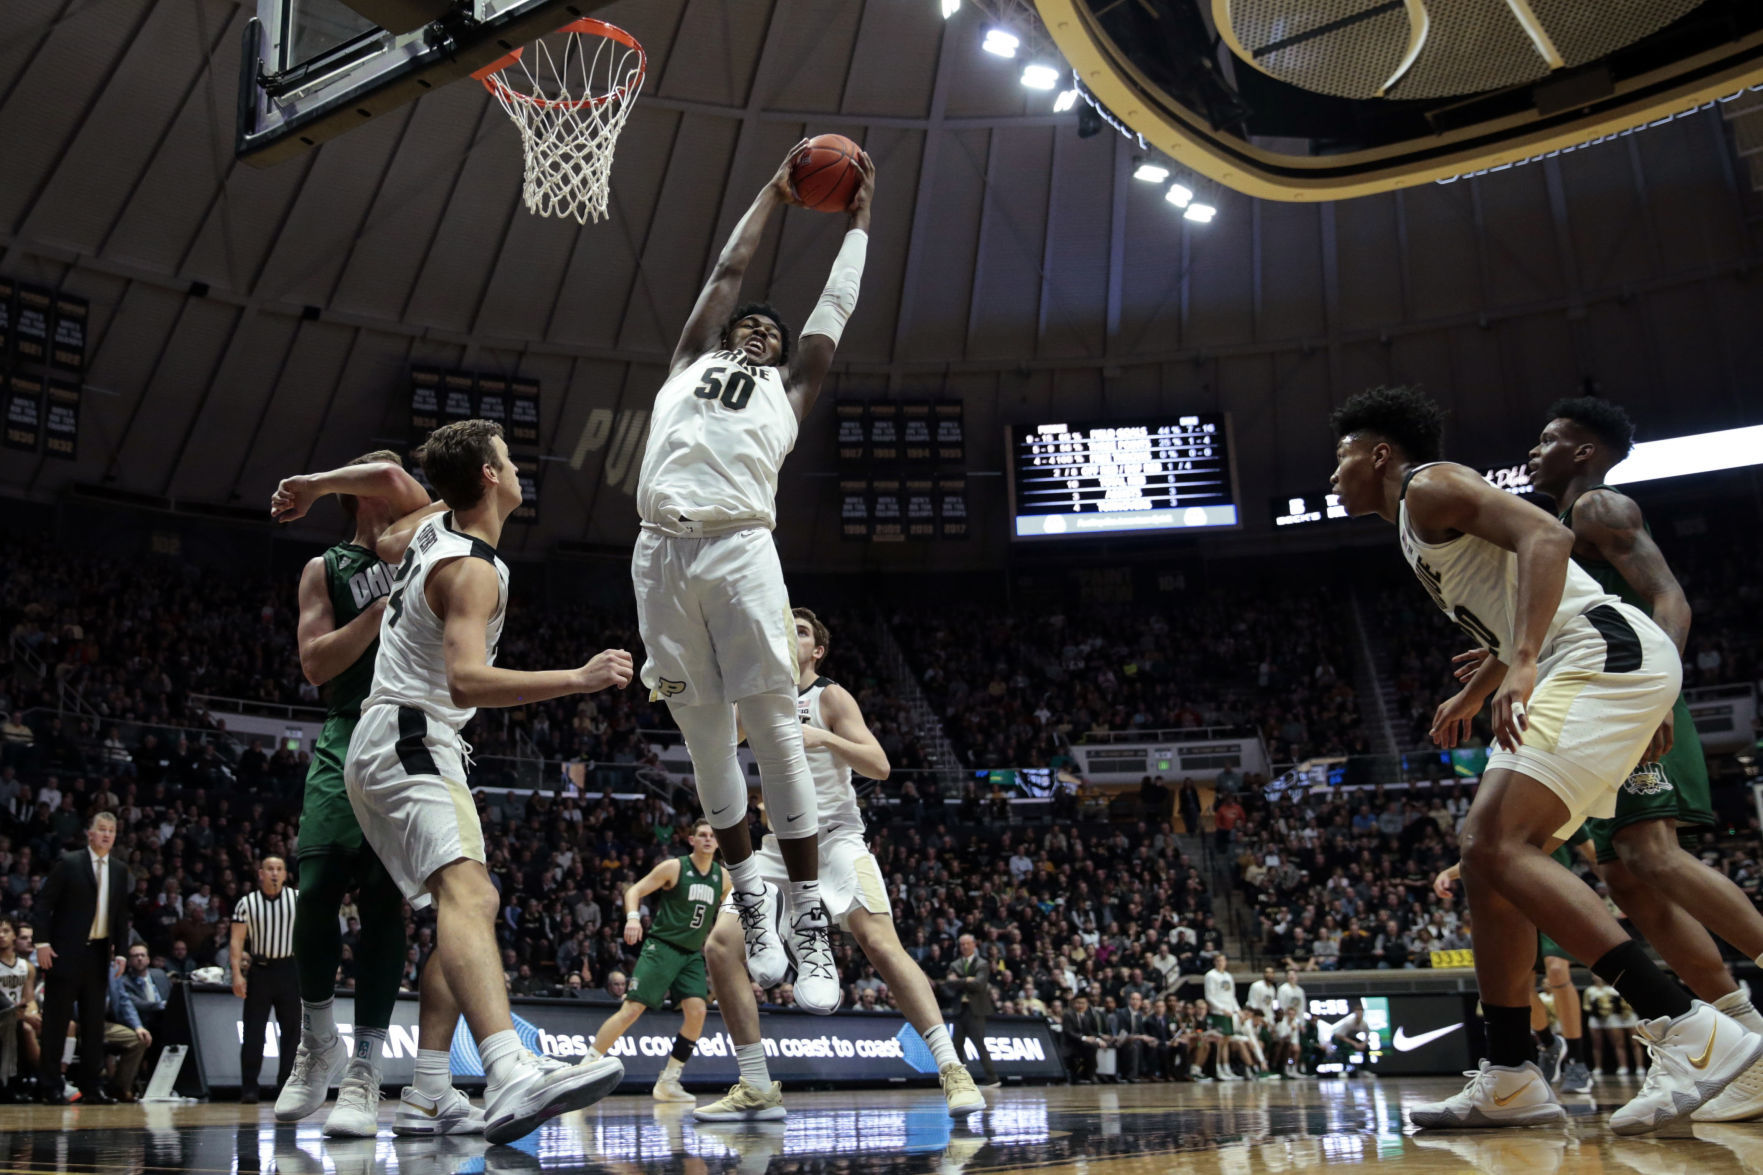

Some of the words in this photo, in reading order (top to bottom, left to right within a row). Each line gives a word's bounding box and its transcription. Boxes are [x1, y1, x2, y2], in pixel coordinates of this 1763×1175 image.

[694, 366, 757, 411] 50
[688, 883, 715, 906] OHIO
[689, 903, 707, 929] 5
[538, 1028, 588, 1056] has
[588, 1035, 637, 1060] ou
[639, 1032, 728, 1056] coved
[780, 1030, 834, 1053] coast
[832, 1030, 855, 1053] to
[855, 1032, 904, 1053] coast
[963, 1036, 1046, 1061] NSSAN
